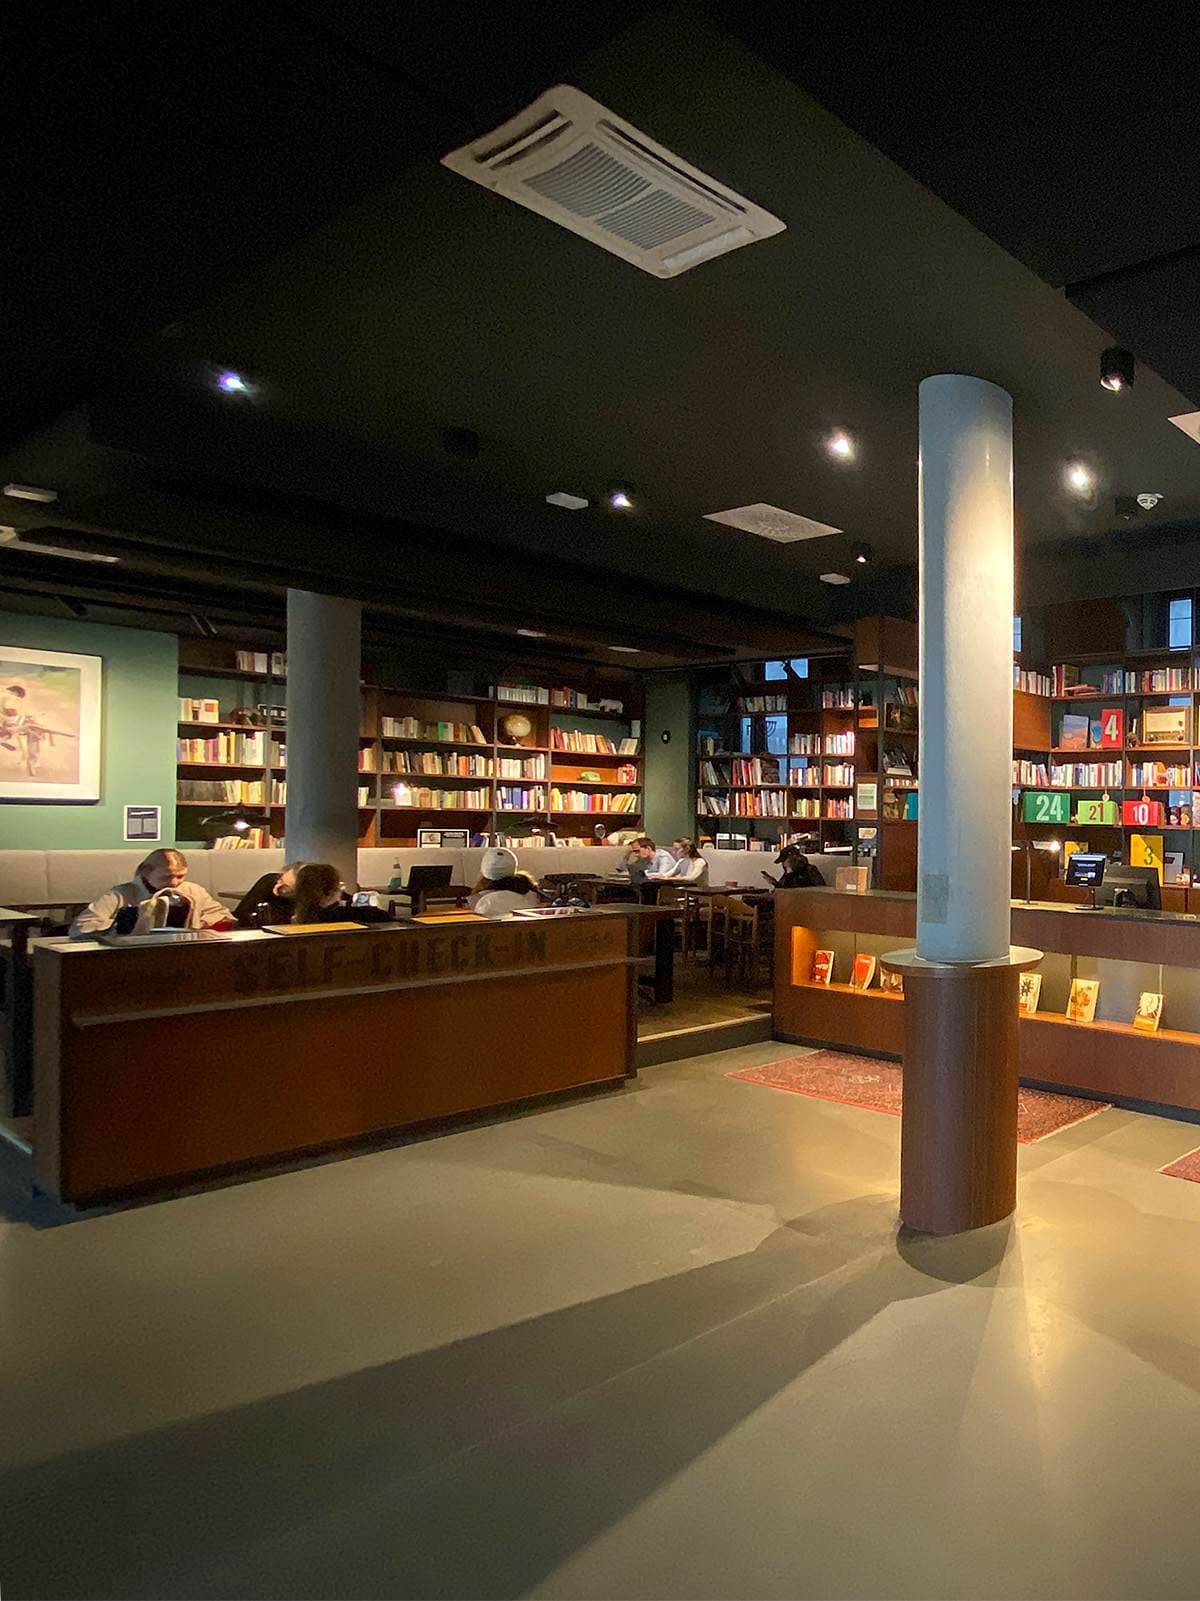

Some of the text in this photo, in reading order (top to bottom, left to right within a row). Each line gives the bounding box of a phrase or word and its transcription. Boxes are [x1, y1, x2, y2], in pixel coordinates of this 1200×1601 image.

[1104, 715, 1119, 741] 4
[1036, 795, 1064, 821] 24
[1089, 802, 1104, 822] 21
[1132, 804, 1149, 826] 10
[1143, 846, 1153, 865] 3
